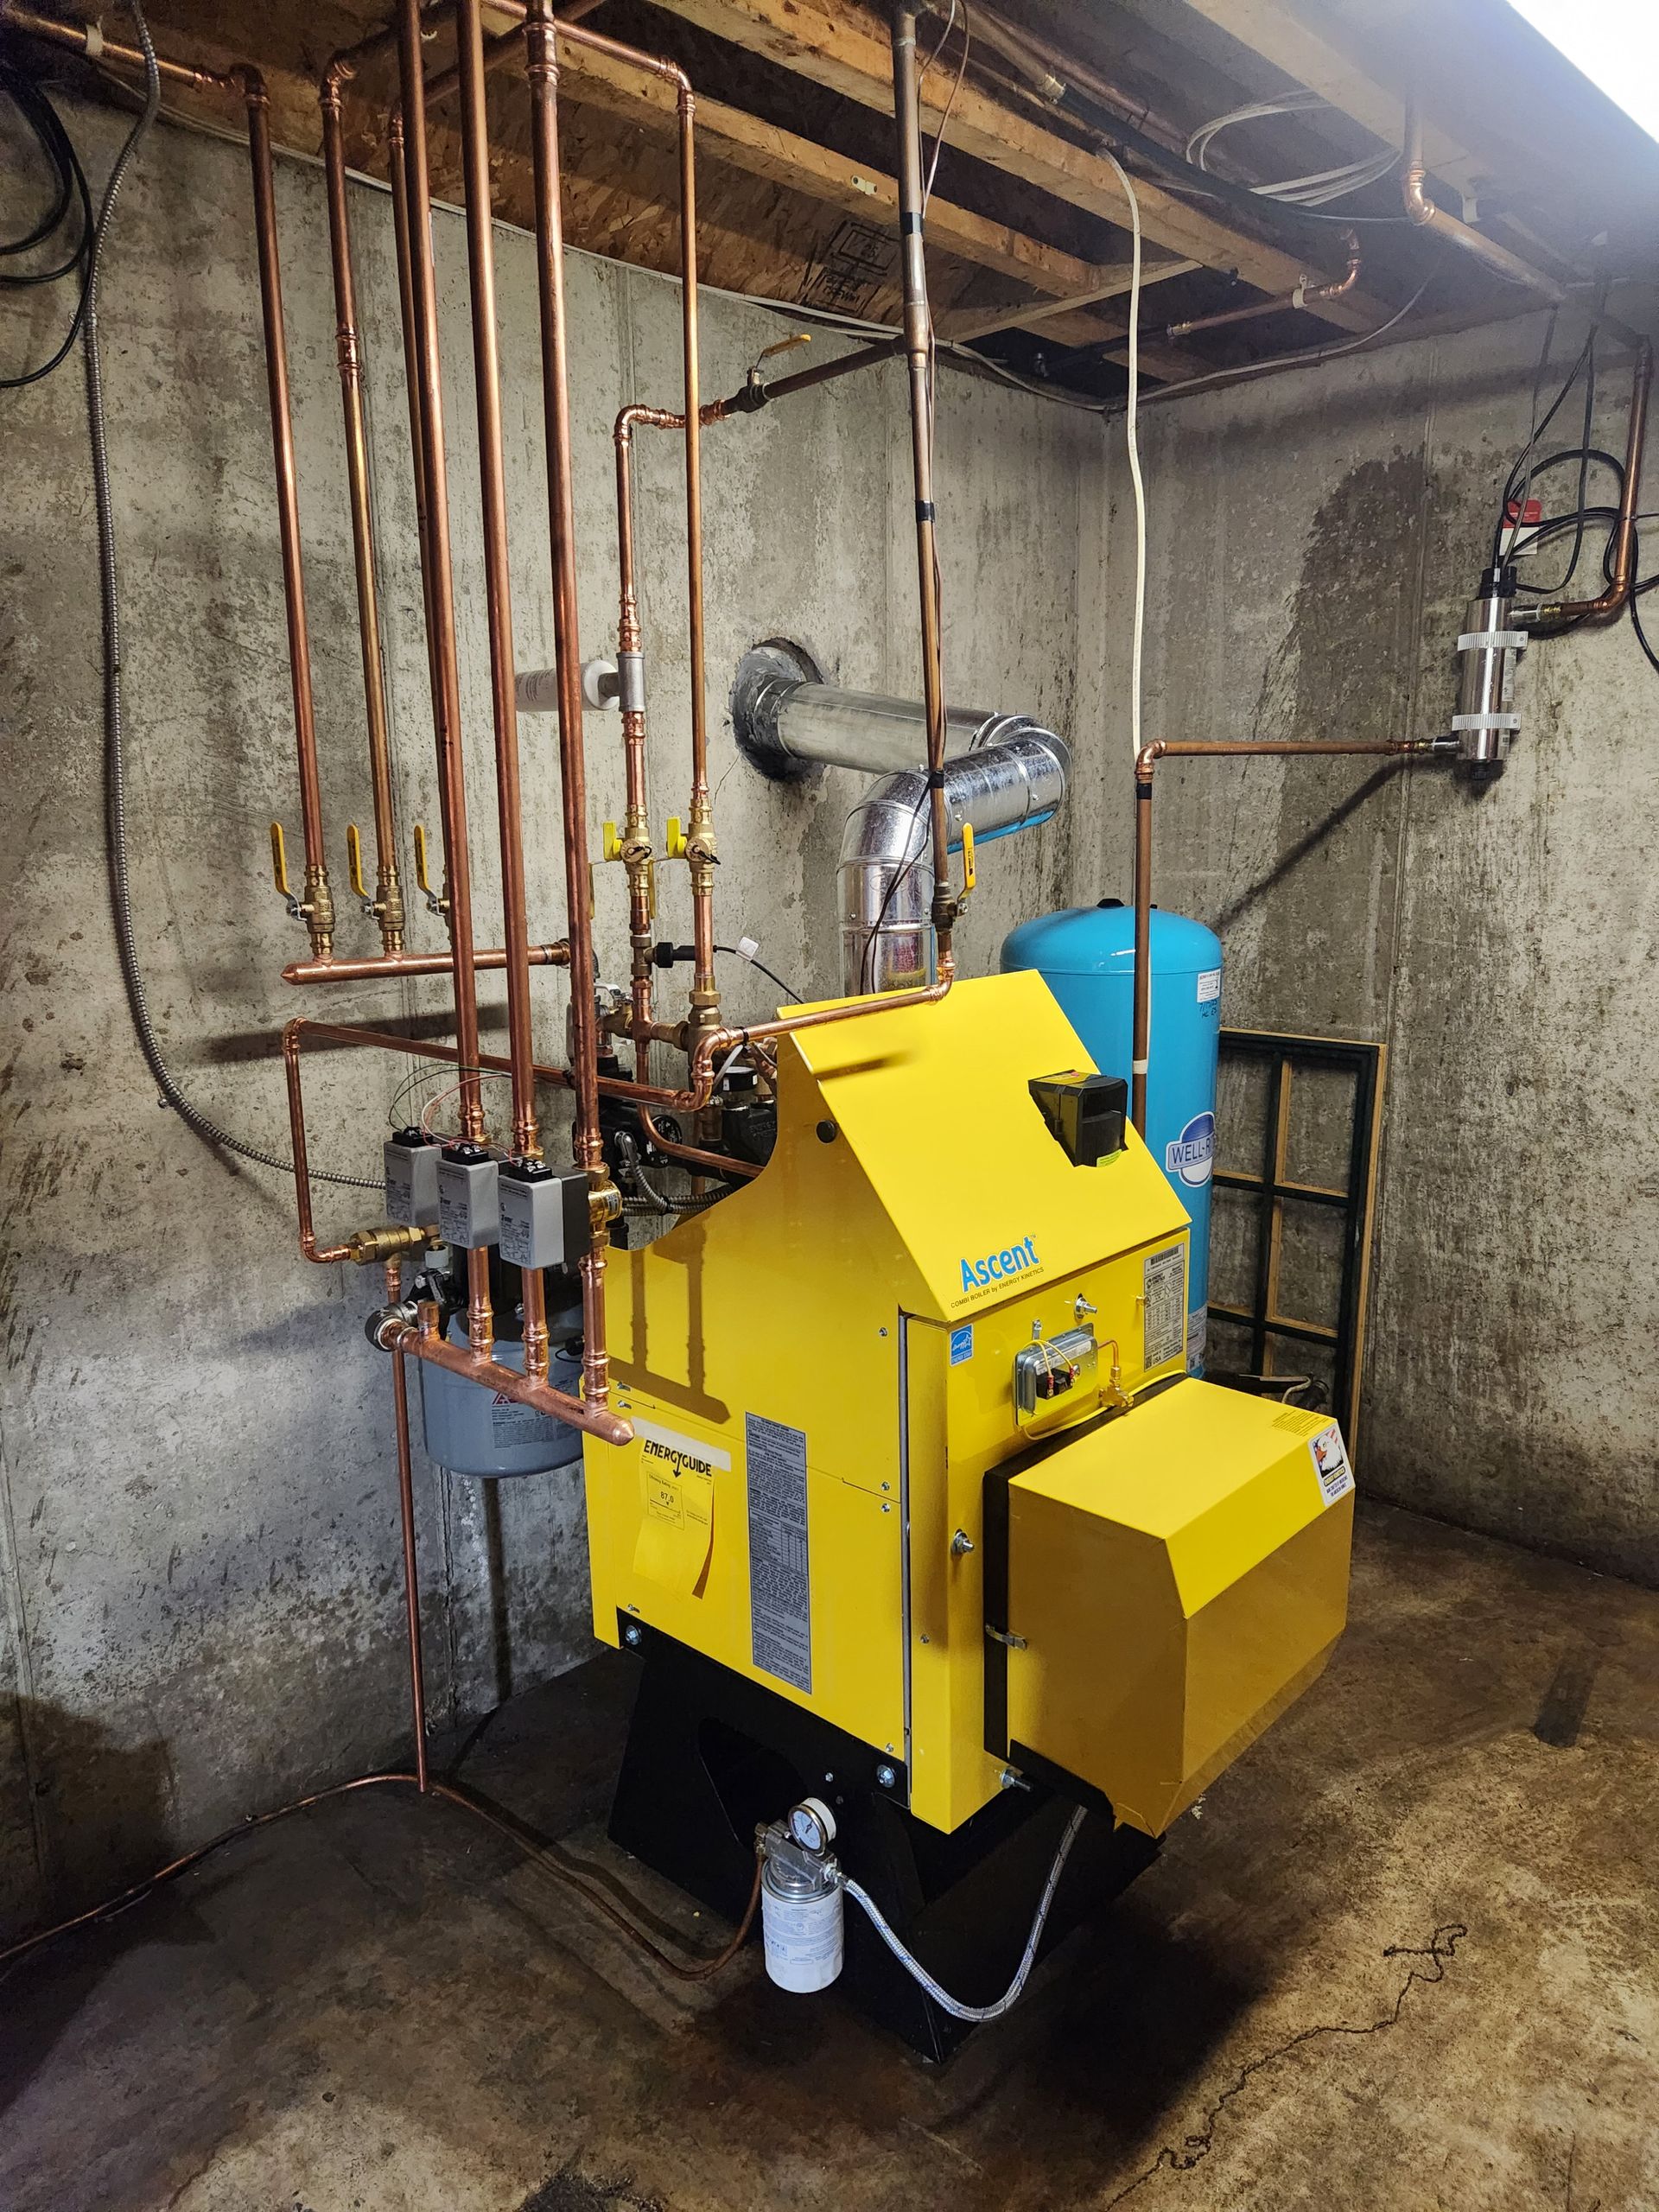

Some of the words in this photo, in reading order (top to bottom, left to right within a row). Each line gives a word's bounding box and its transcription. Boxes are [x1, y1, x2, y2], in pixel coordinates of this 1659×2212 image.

[960, 1236, 1039, 1293] Ascent
[950, 1297, 969, 1309] COMBI
[970, 1288, 990, 1300] BOILER
[999, 1276, 1020, 1290] ENERGY
[1020, 1267, 1045, 1280] KINETICS
[644, 1440, 712, 1478] ENERGYGUIDE
[660, 1491, 674, 1503] 87.0
